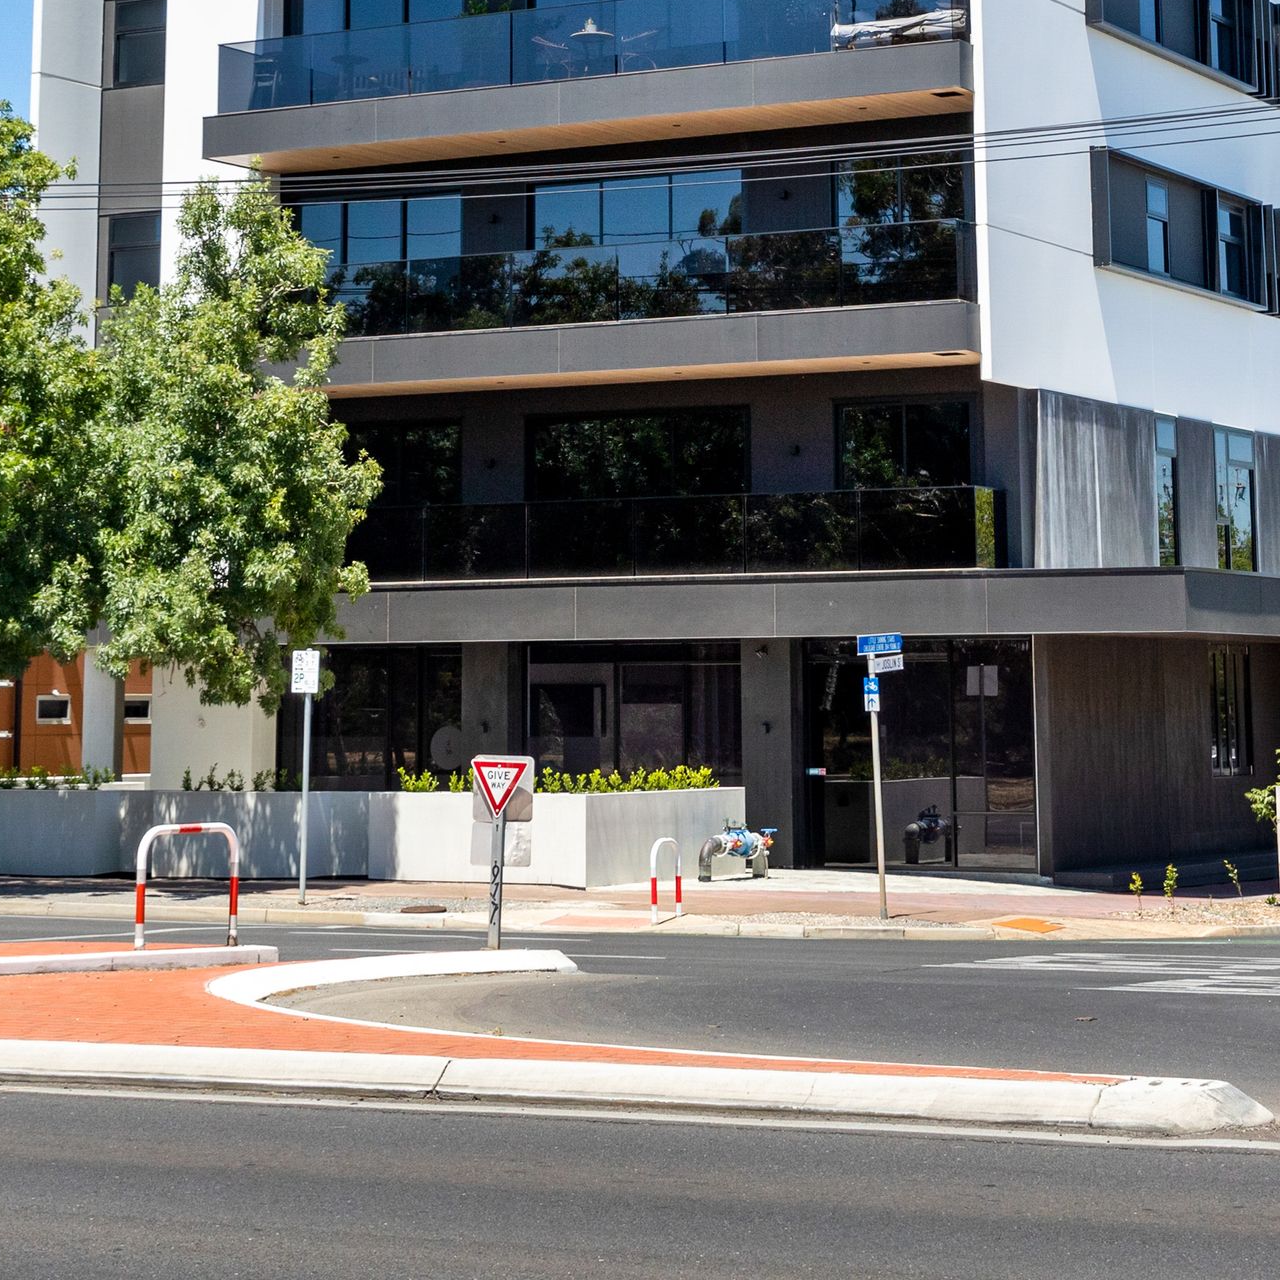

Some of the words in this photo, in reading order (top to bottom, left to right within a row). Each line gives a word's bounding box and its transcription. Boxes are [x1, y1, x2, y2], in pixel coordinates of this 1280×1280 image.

[882, 658, 897, 670] JOSLIN
[294, 672, 304, 684] 2P
[487, 770, 511, 780] GIVE
